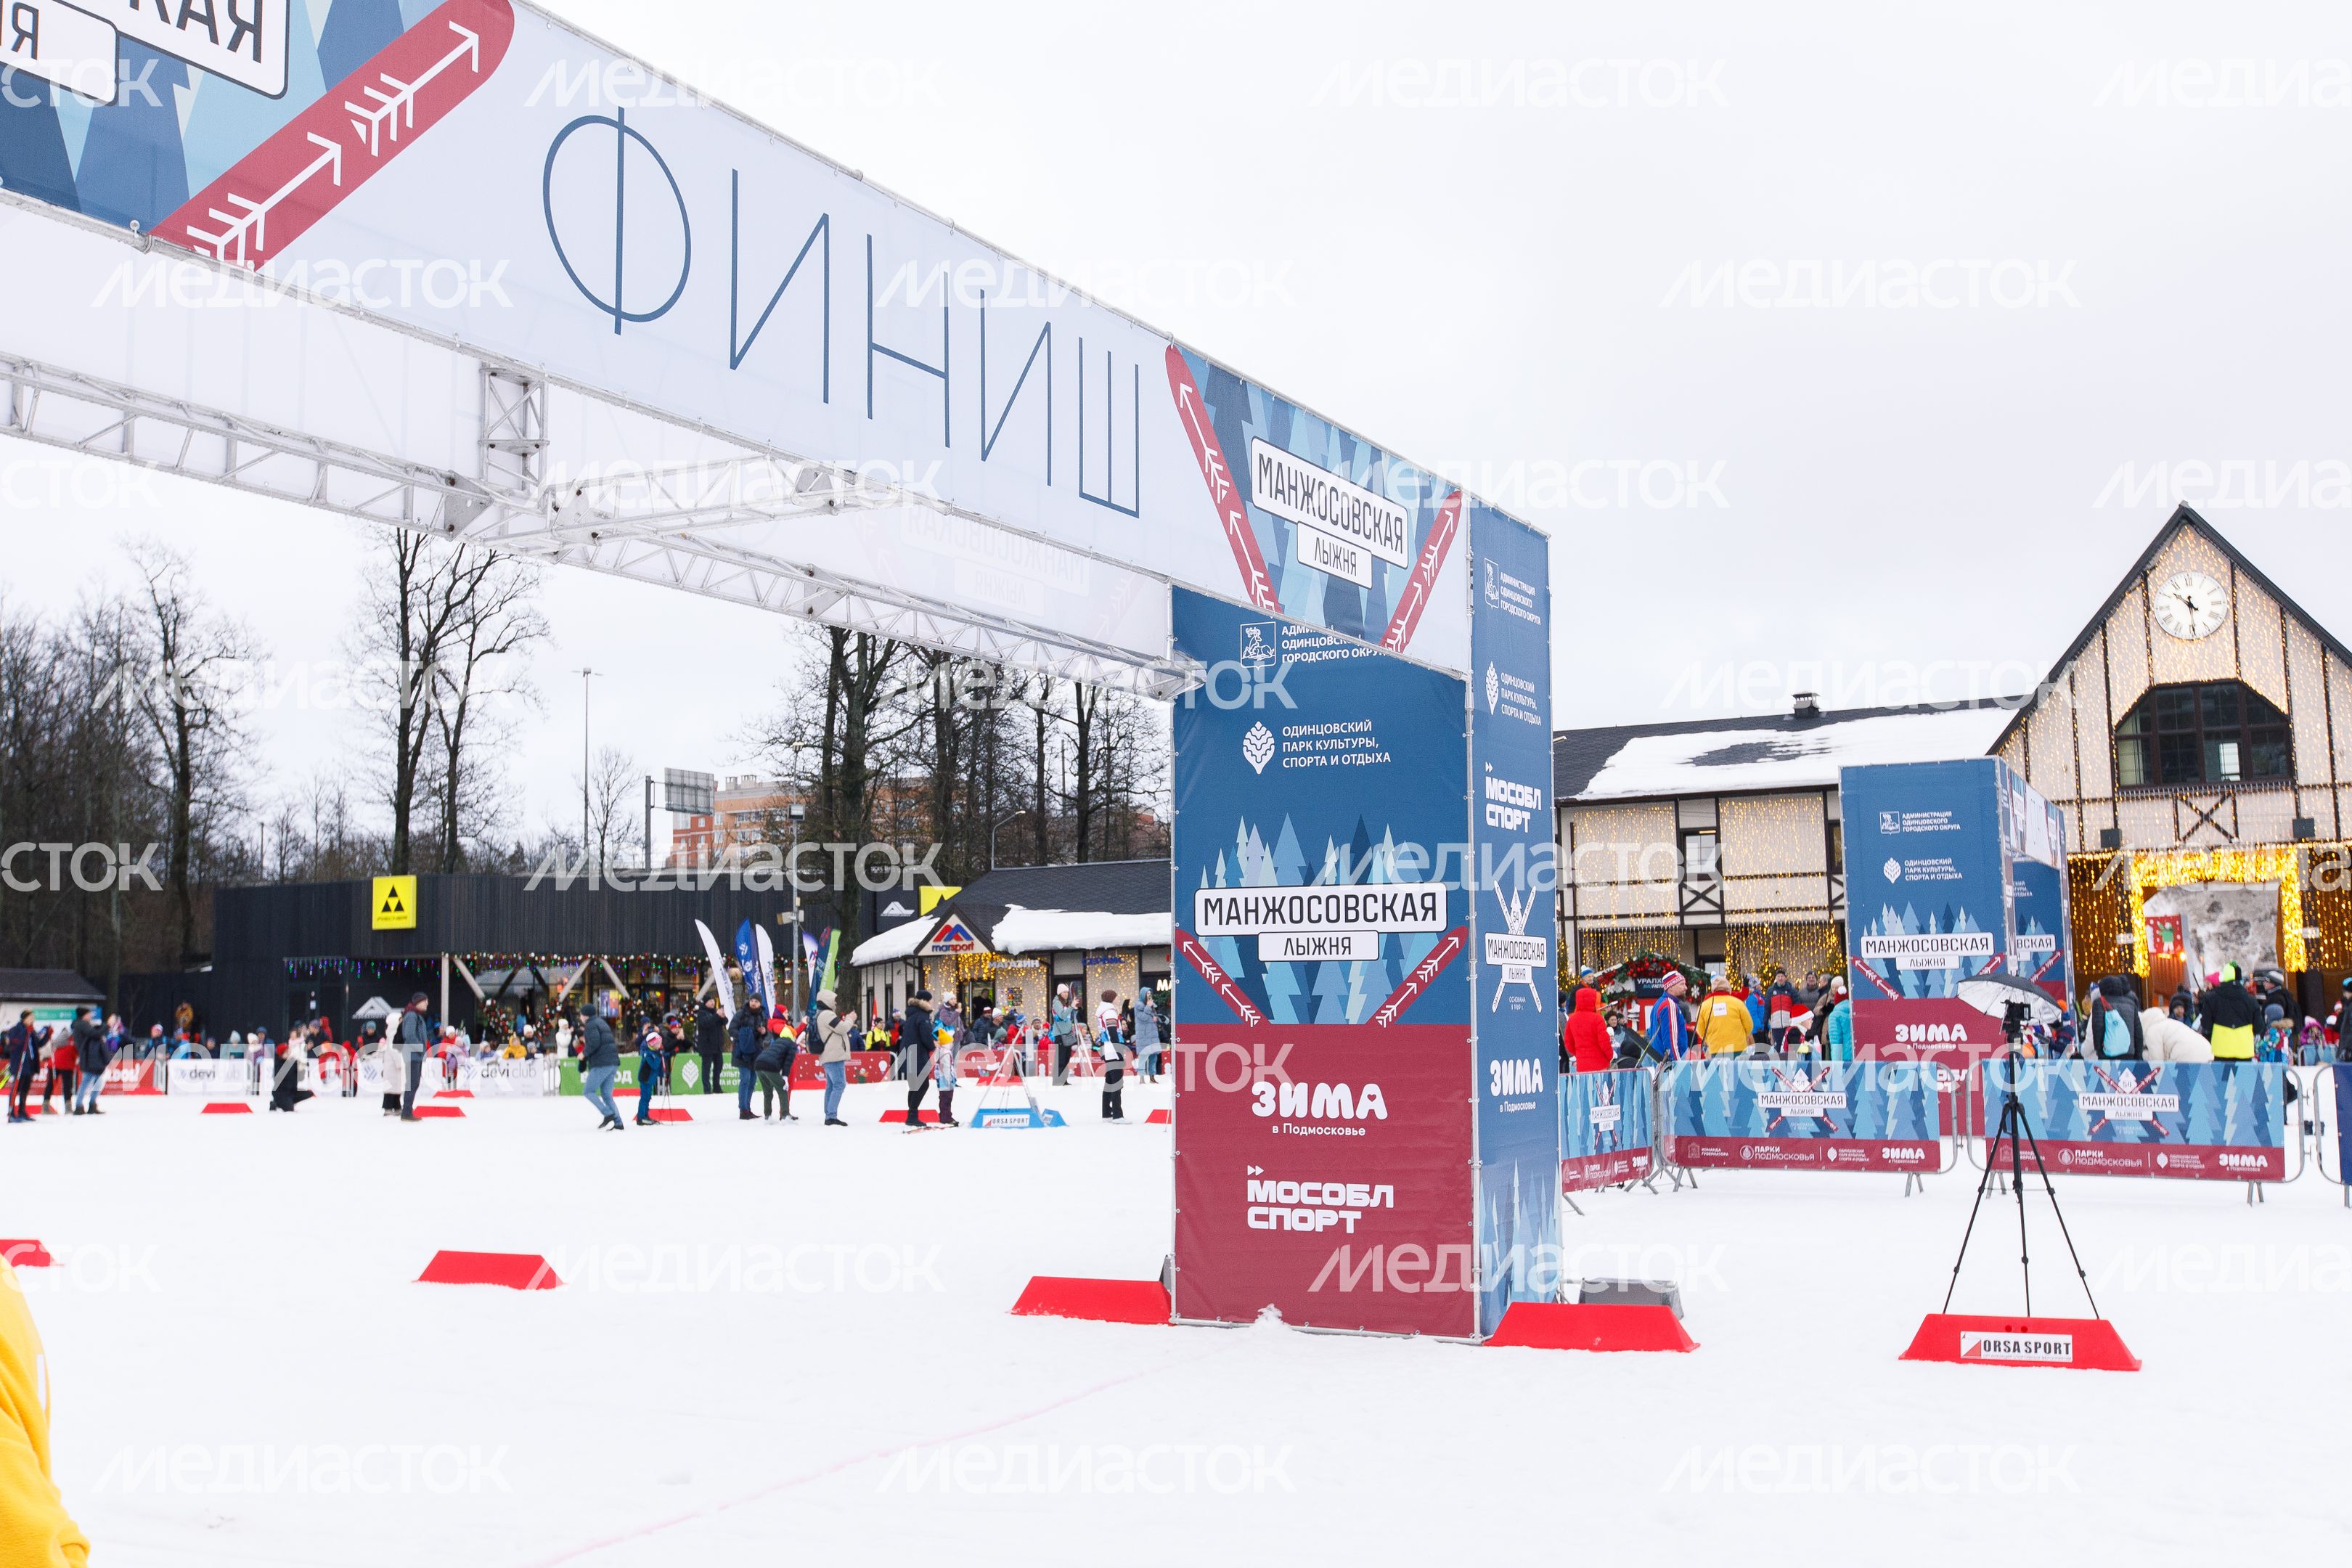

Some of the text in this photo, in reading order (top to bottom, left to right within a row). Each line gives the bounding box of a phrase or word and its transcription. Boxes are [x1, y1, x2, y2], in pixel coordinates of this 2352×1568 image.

[543, 107, 1140, 518] ФИНИШ
[1258, 452, 1403, 555] МАНЖОСОВСКАЯ
[1314, 536, 1357, 576] ЛЫЖНЯ
[1282, 649, 1349, 663] ГОРОДСКОГО
[1500, 671, 1535, 693] ОДИНЦОВСКИЙ
[1500, 687, 1514, 703] ПАРК
[1501, 703, 1519, 721] СПОРТА
[1524, 711, 1541, 726] ОТДЫХА
[1282, 719, 1372, 737] ОДИНЦОВСКИЙ
[1283, 737, 1379, 753] ПАРК КУЛЬТУРЫ,
[1283, 751, 1392, 768] СПОРТА И ОТДЫХА
[1485, 775, 1542, 812] МОСОБЛ
[1485, 802, 1531, 833] СПОРТ
[1902, 811, 1952, 820] АДМИНИСТРАЦИЯ
[1902, 817, 1948, 826] ОДИНЦОВСКОГО
[1904, 857, 1952, 867] ОДИНЦОВСКИЙ
[1203, 891, 1438, 927] МАНЖОСОВСКАЯ
[932, 942, 974, 952] marsport
[1283, 935, 1352, 957] ЛЫЖНЯ
[1487, 939, 1545, 962] МАНЖОСОВСКАЯ
[1865, 936, 1989, 954] МАНЖОСОВСКАЯ
[988, 960, 1040, 968] МАГАЗИН
[1909, 957, 1946, 968] ЛЫЖНЯ
[1895, 1023, 1968, 1042] ЗИМА
[481, 1063, 537, 1079] devi club
[1490, 1058, 1543, 1097] ЗИМА
[1251, 1081, 1388, 1120] ЗИМА
[1505, 1100, 1536, 1113] Подмосковье
[1761, 1095, 1843, 1106] МАНЖОСОВСКАЯ
[2082, 1096, 2176, 1108] МАНЖОСОВСКАЯ
[1272, 1122, 1366, 1137] в Подмосковье
[1882, 1147, 1926, 1160] ЗИМА
[2075, 1149, 2103, 1158] ПАРКИ
[2218, 1153, 2268, 1167] ЗИМА
[2075, 1157, 2142, 1167] ПОДМОСКОВЬЯ
[1247, 1180, 1395, 1209] МОСОБЛ
[1247, 1206, 1362, 1233] СПОРТ
[1983, 1340, 2071, 1355] ORSA SPORT
